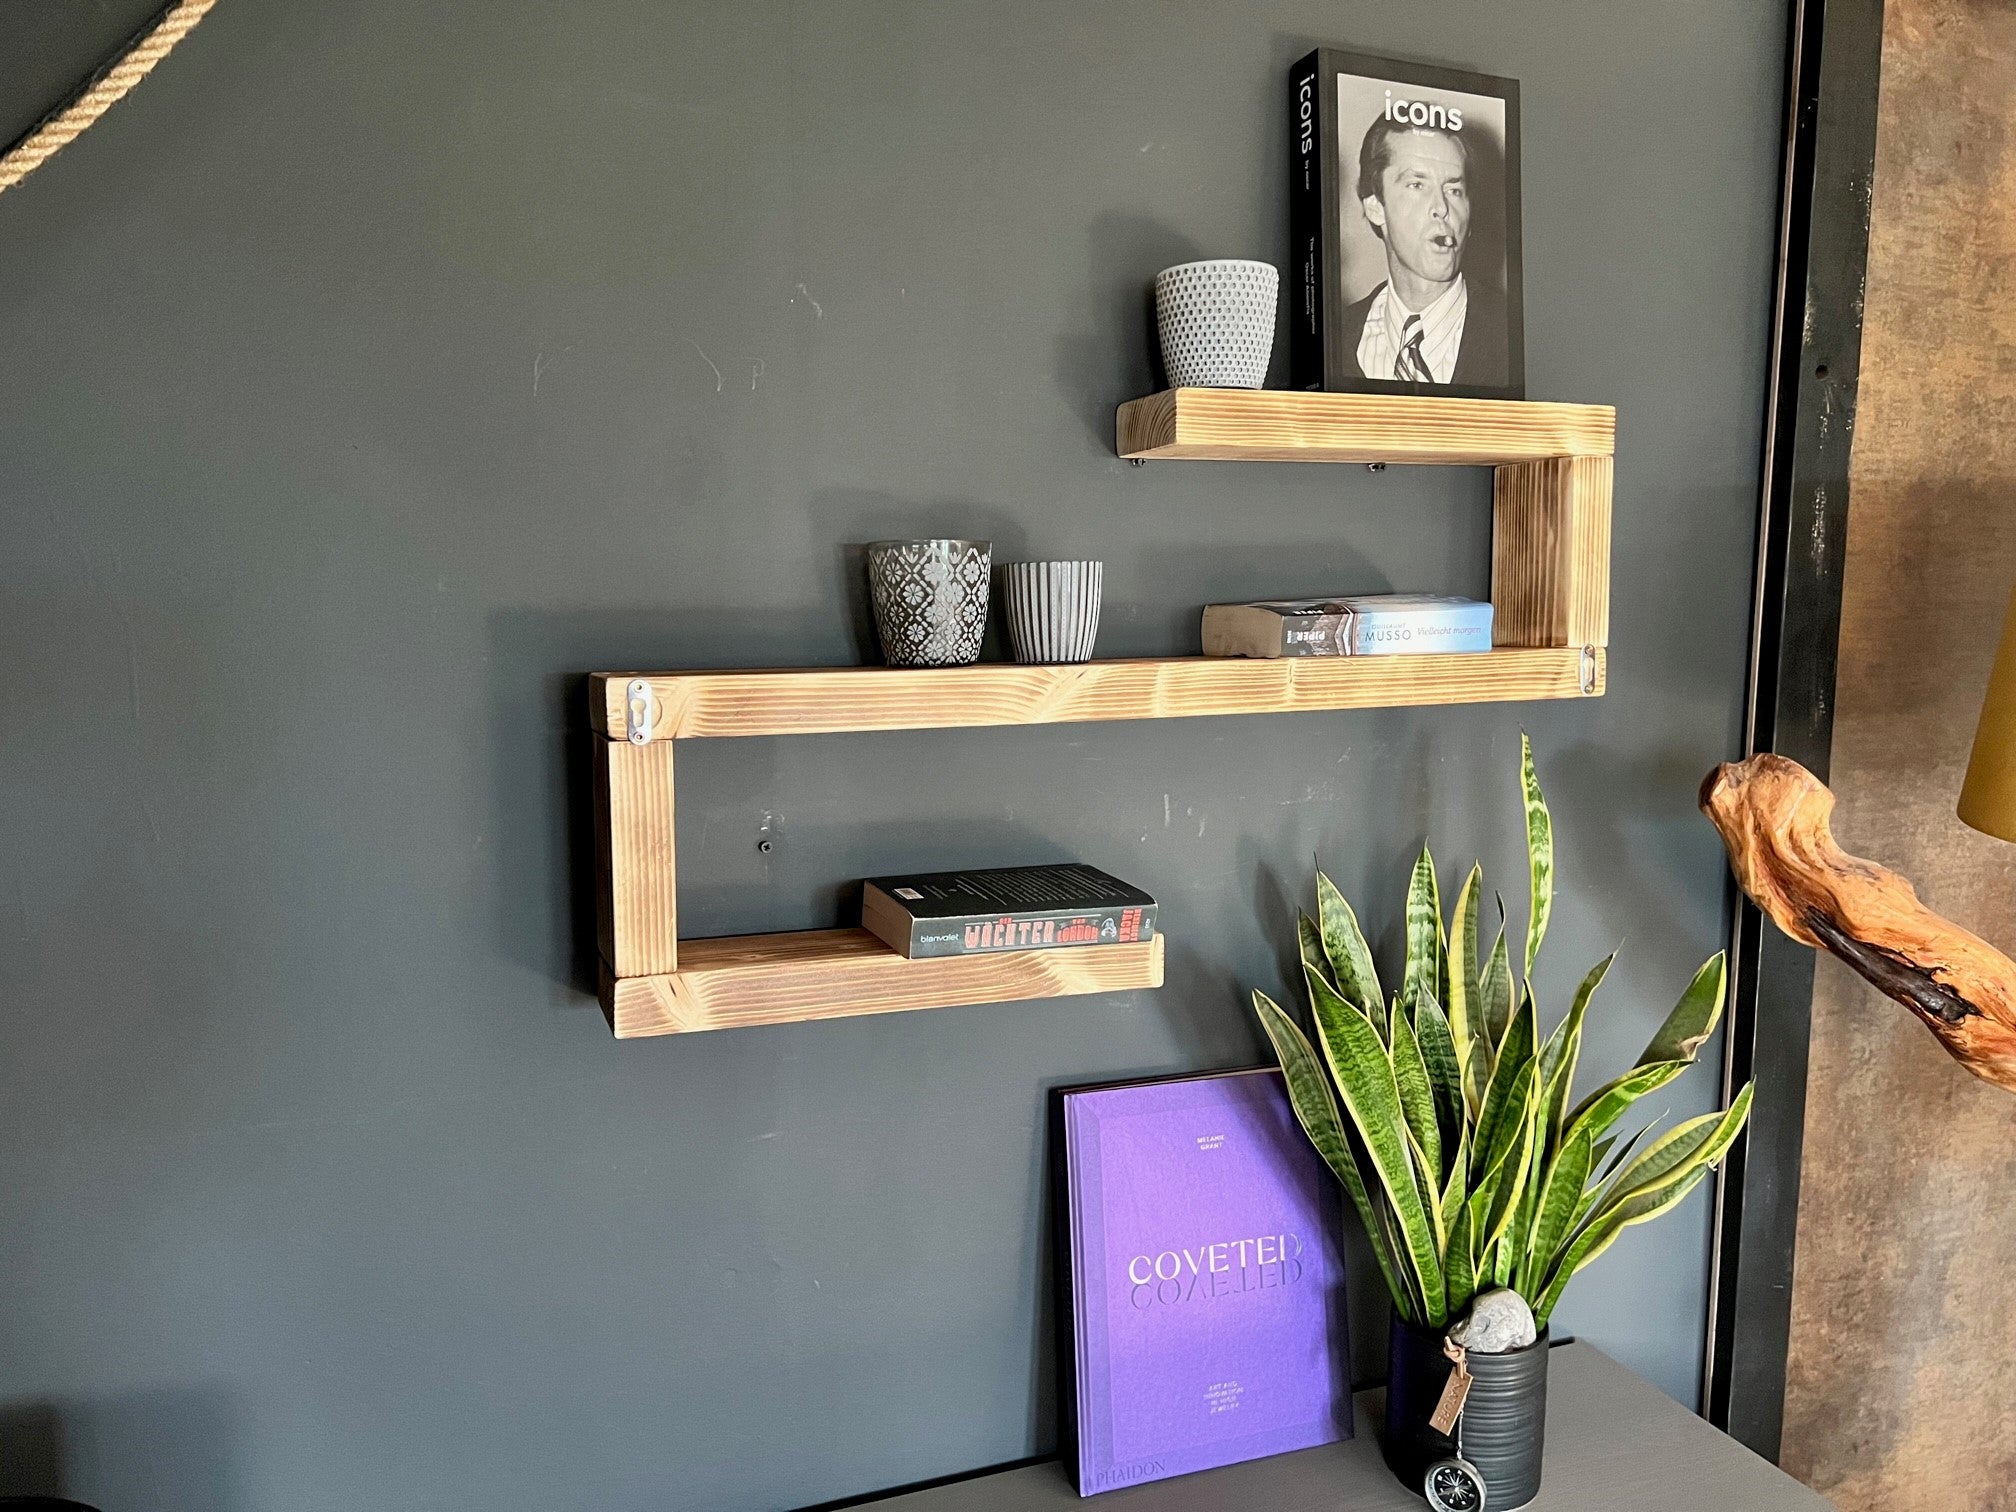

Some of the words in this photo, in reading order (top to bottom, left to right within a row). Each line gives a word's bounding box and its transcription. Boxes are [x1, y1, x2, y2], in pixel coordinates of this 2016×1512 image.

[1299, 73, 1315, 154] icons
[1384, 89, 1463, 131] icons
[1296, 630, 1326, 642] PIPER
[1364, 629, 1412, 642] MUSSO
[1417, 626, 1452, 636] Vielleicht
[1453, 627, 1482, 637] morgen
[920, 933, 960, 943] blanvalet
[1056, 924, 1099, 943] LONDON
[1128, 1233, 1303, 1286] COVETED
[1096, 1460, 1166, 1488] PHAIDON
